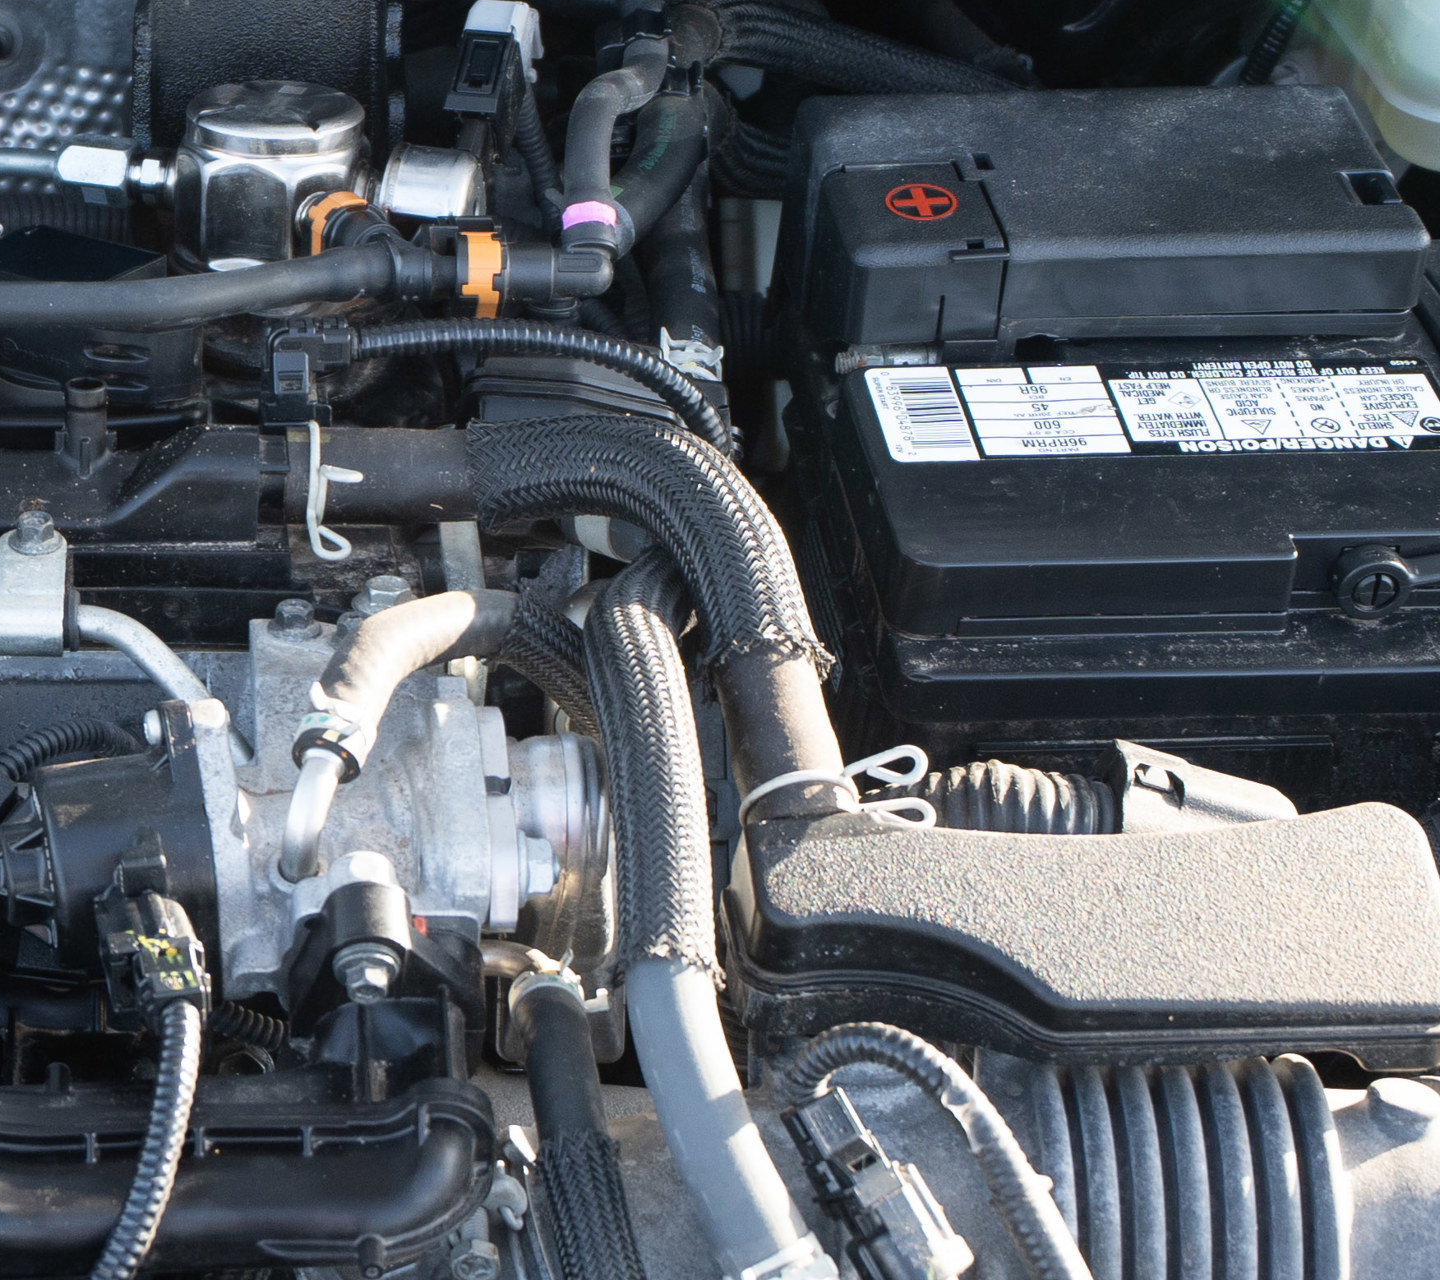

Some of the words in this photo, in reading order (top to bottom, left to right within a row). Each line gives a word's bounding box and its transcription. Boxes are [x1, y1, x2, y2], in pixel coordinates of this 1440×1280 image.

[1243, 361, 1271, 370] OPEN
[1273, 361, 1295, 369] NOT
[1296, 360, 1312, 368] DO
[1170, 371, 1186, 379] DO
[1260, 369, 1296, 377] REACH
[1297, 368, 1319, 376] THE
[1319, 368, 1334, 376] OF
[1359, 367, 1386, 375] KEEP
[1019, 386, 1048, 394] 96R
[1119, 389, 1165, 397] MEDICAL
[886, 385, 904, 411] 83996
[1137, 397, 1156, 405] GET
[1380, 393, 1414, 401] GASES
[1031, 403, 1048, 412] 45
[1360, 401, 1418, 411] EXPLOSIVE
[1034, 420, 1061, 430] 600
[1137, 420, 1206, 429] IMMEDIATELY
[1358, 422, 1394, 430] SHIELD
[1148, 430, 1175, 438] EYES
[1177, 428, 1210, 437] FLUSH
[1021, 438, 1087, 448] 96RPRM
[1178, 437, 1389, 453] DANGER/POISON
